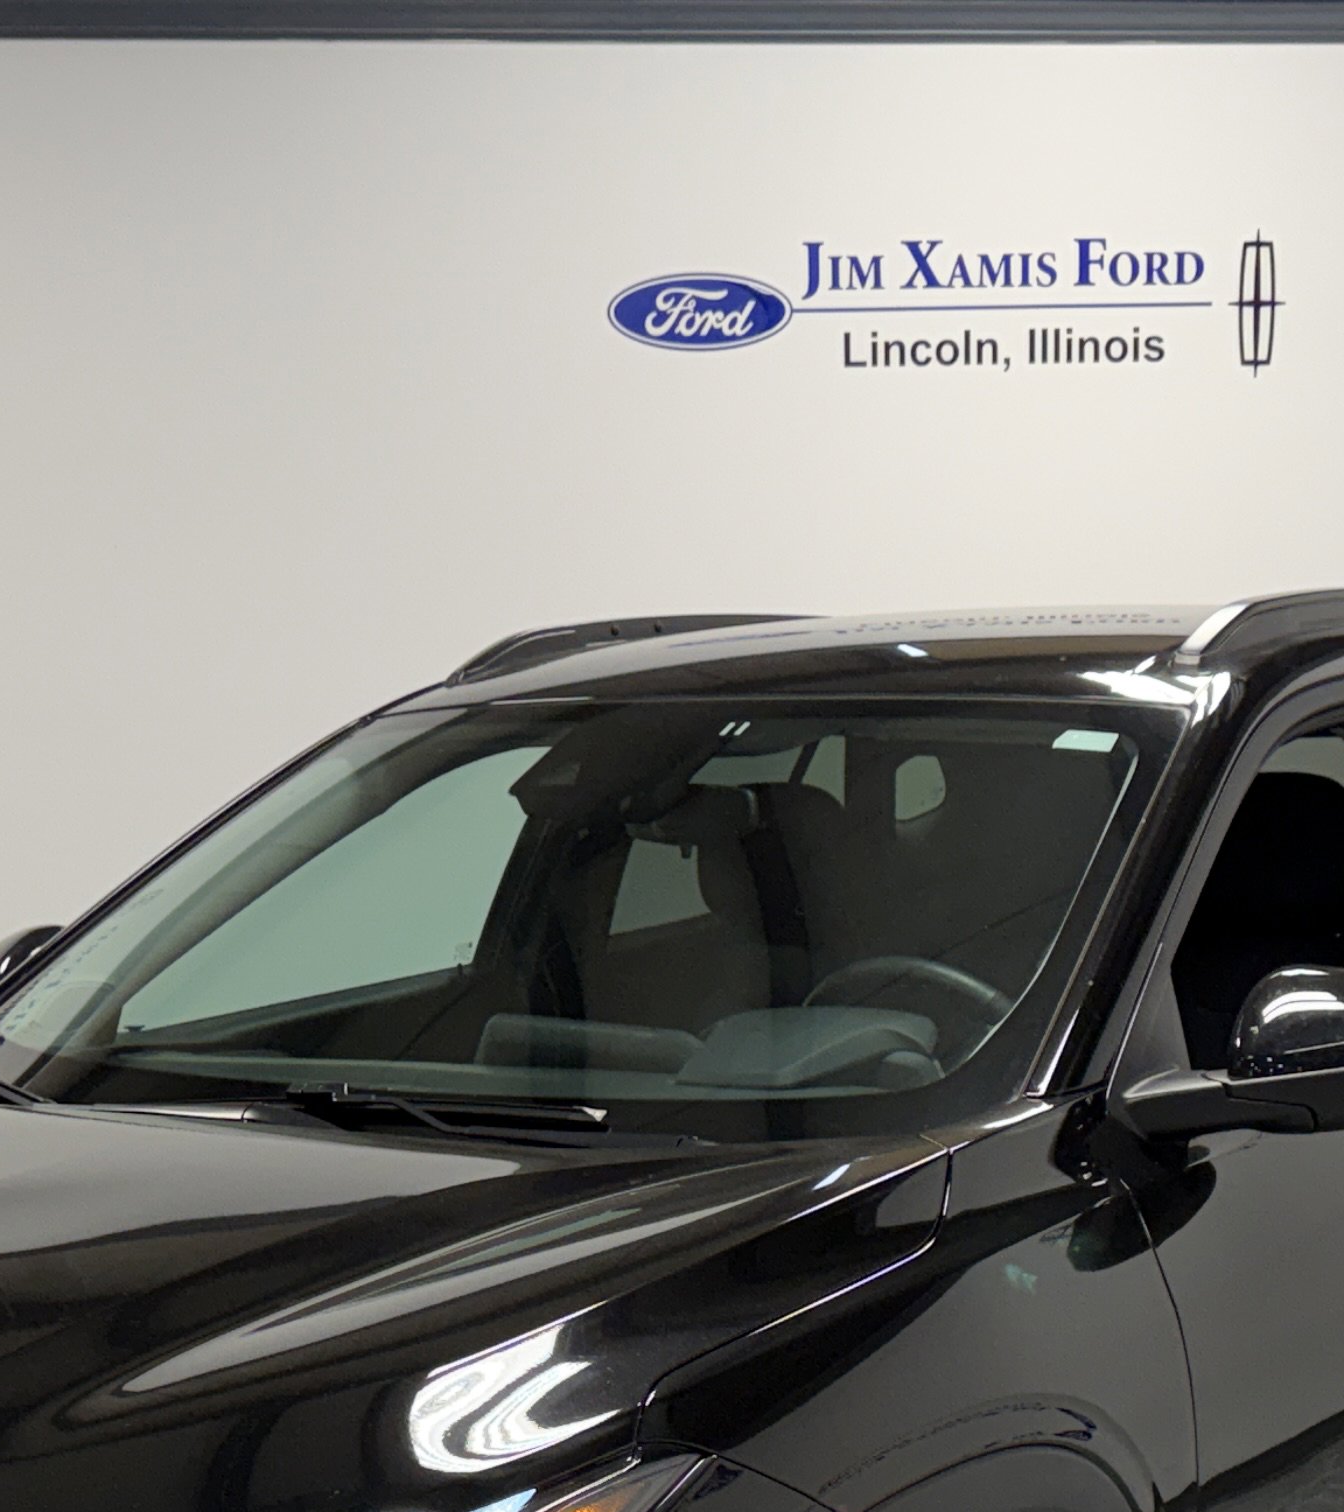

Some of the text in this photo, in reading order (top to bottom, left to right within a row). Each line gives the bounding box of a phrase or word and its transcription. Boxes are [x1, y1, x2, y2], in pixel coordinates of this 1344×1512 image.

[801, 238, 1206, 301] JIM XAMIS FORD
[644, 286, 757, 338] Ford
[843, 326, 1165, 372] Lincoln, Illinois
